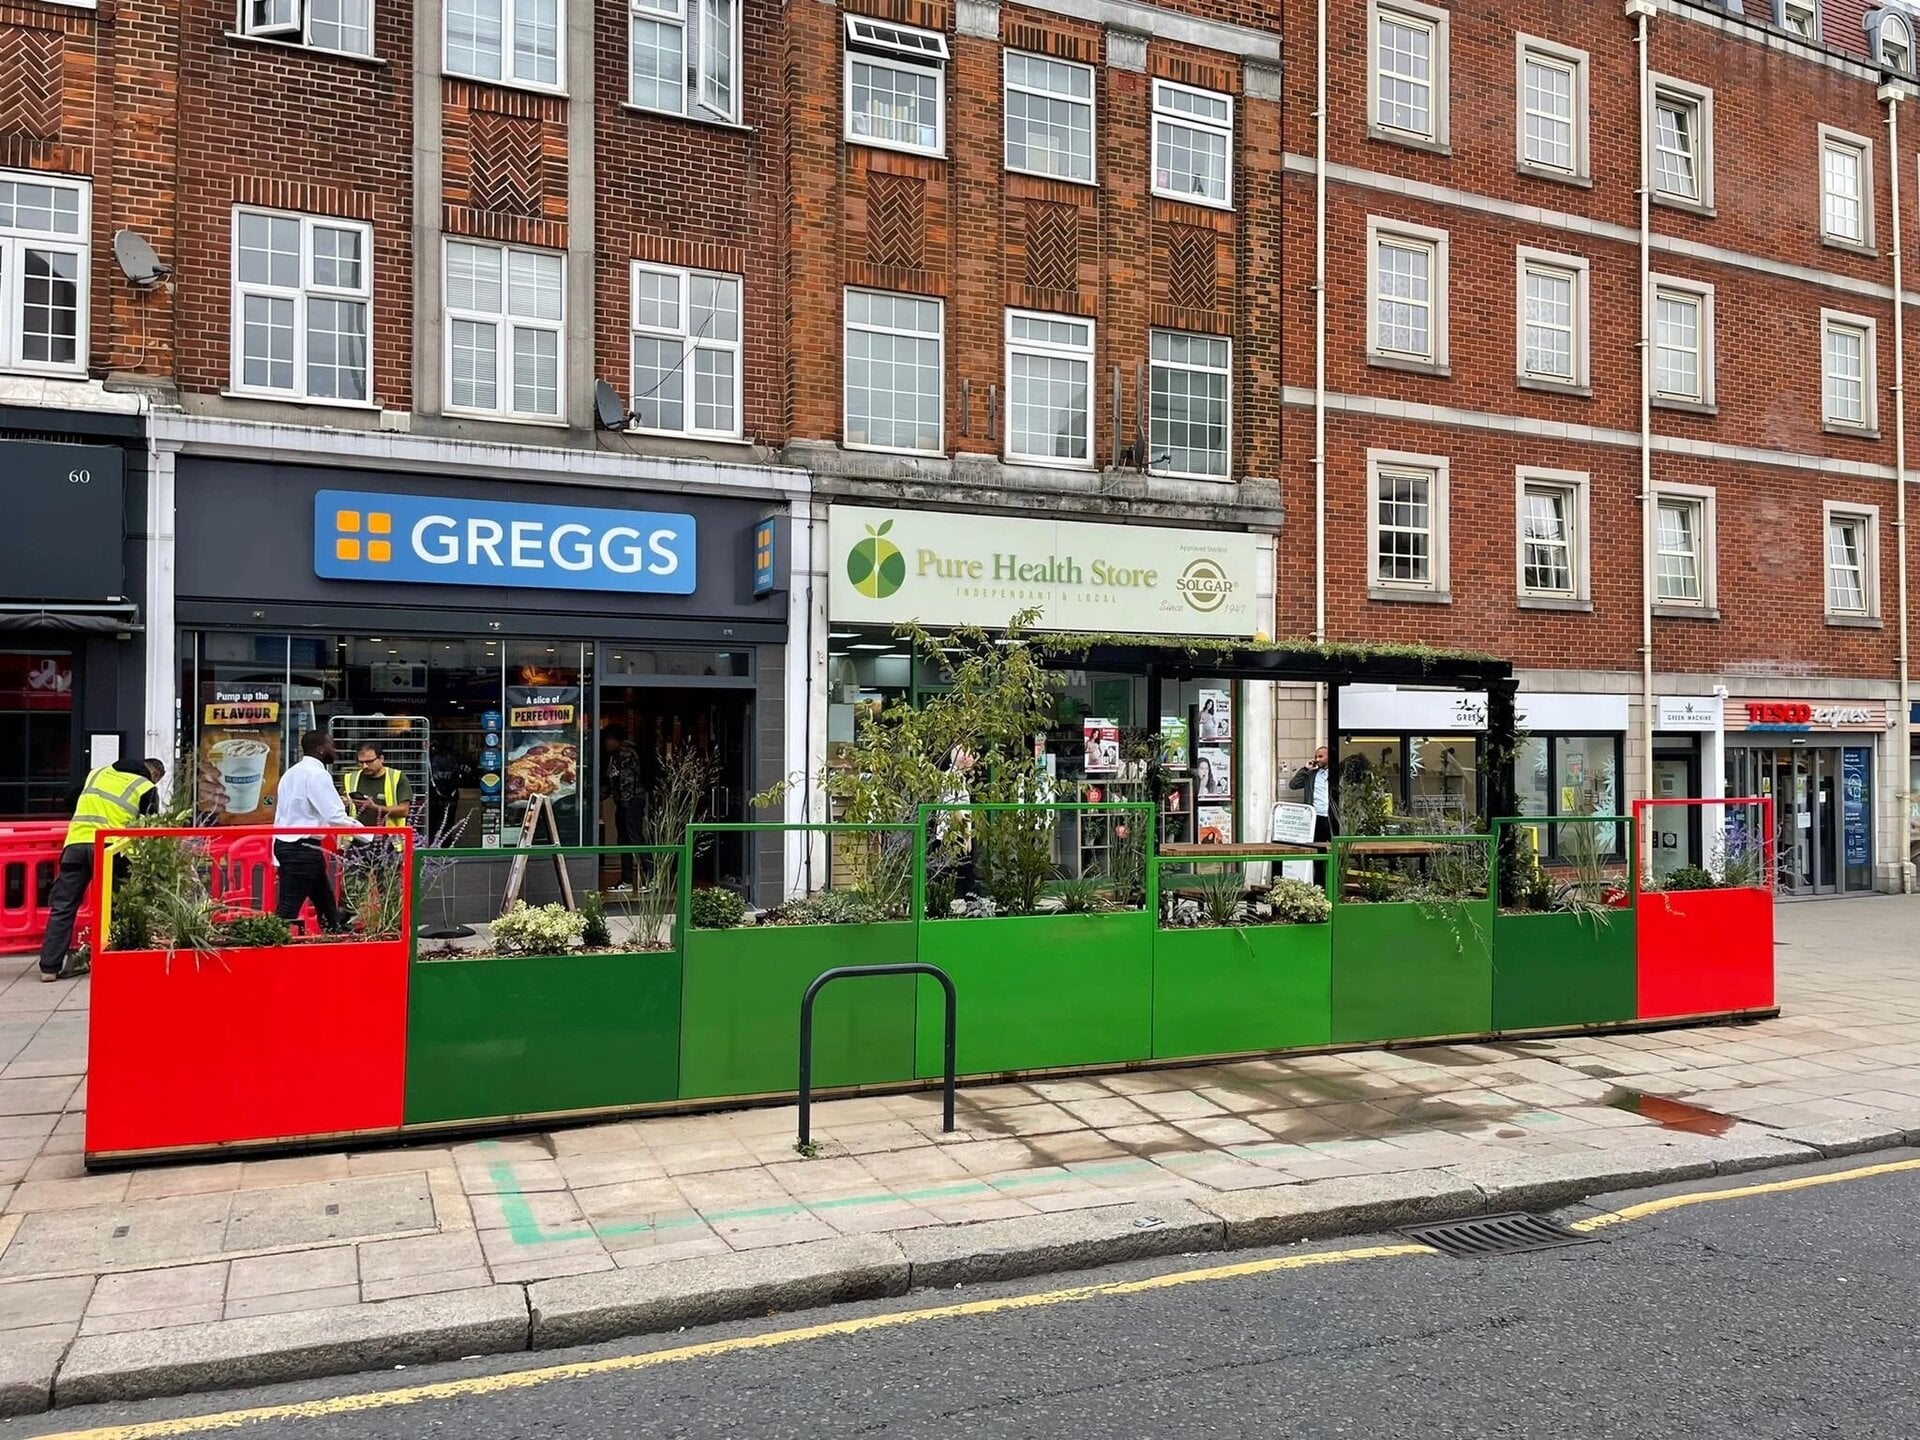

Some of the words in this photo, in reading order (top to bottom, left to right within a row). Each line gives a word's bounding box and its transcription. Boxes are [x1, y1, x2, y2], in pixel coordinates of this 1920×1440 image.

[69, 469, 90, 484] 60
[411, 514, 679, 576] GREGGS
[917, 549, 983, 579] Pure
[993, 553, 1083, 584] Health
[1090, 559, 1159, 588] Store
[1176, 578, 1233, 592] SOLGAR
[1077, 593, 1117, 603] LOCAL
[1159, 599, 1184, 613] Since
[216, 692, 240, 702] Pump
[242, 694, 253, 702] up
[255, 692, 269, 700] the
[533, 695, 550, 704] slice
[552, 695, 560, 703] of
[213, 707, 271, 720] FLAVOUR
[515, 709, 570, 722] PERFECTION
[1745, 704, 1811, 723] TESCO
